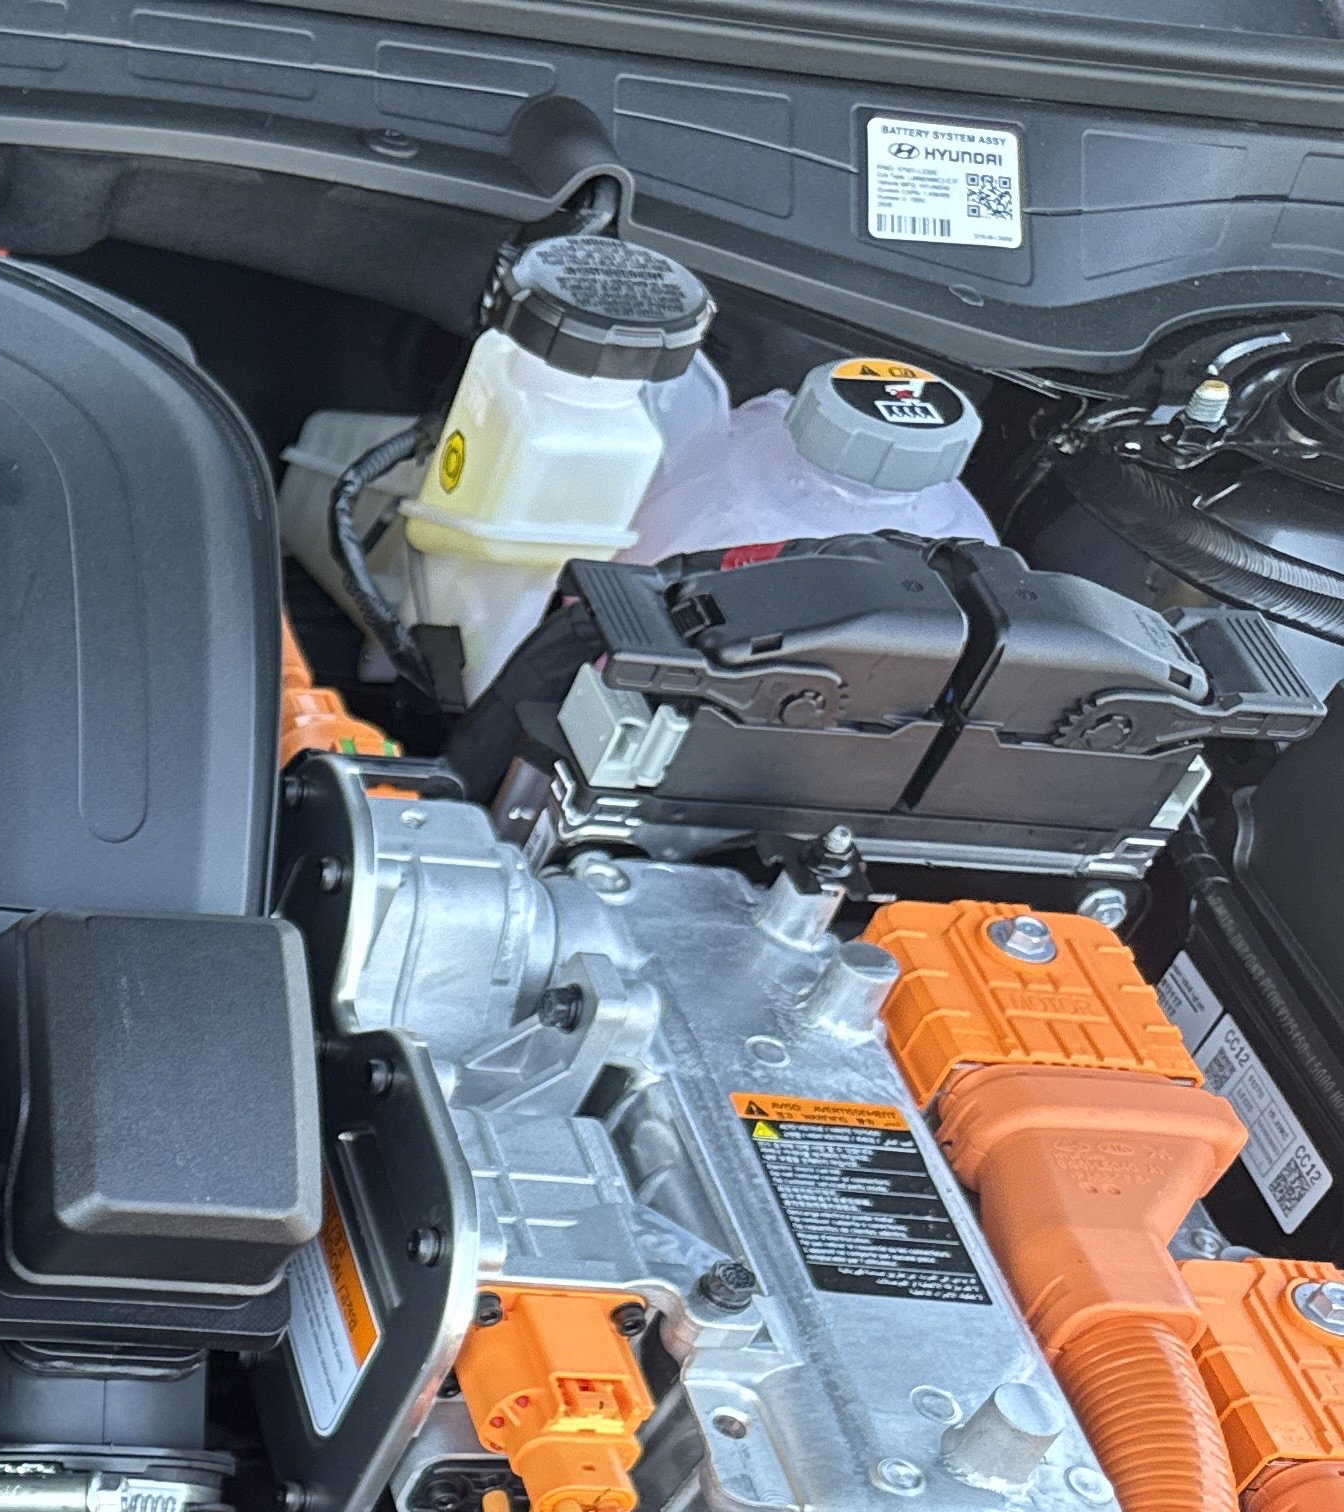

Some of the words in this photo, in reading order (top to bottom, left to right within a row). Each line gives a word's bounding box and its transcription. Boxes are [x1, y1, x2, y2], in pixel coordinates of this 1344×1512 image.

[881, 125, 930, 139] BATTERY
[932, 130, 976, 143] SYSTEM
[978, 135, 1007, 147] ASSY
[924, 146, 1003, 167] HYUNDAI
[1224, 1029, 1250, 1067] CC12
[1294, 1144, 1323, 1184] CC12
